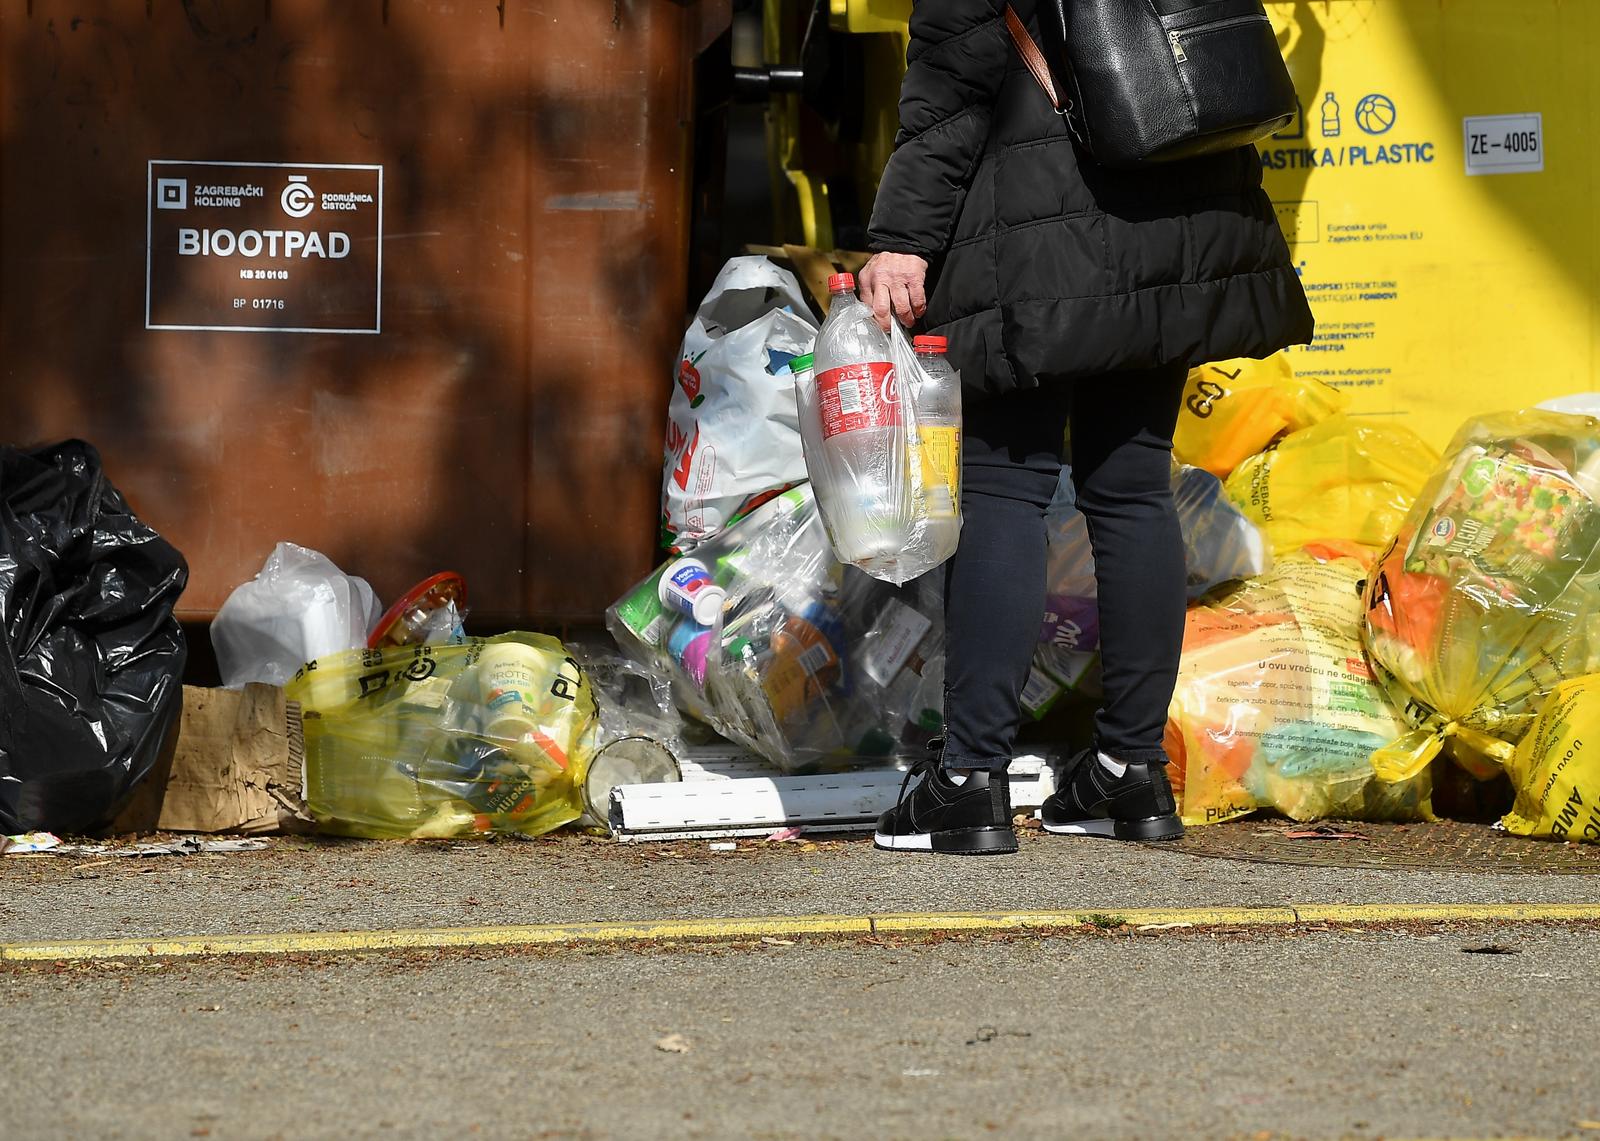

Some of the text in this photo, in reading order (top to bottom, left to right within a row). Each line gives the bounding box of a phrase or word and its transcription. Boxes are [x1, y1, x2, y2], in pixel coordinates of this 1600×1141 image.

[1261, 147, 1335, 170] ASTIKA
[1350, 142, 1434, 166] PLASTIC
[195, 184, 263, 197] ZAGREBAČKI
[195, 197, 241, 207] HOLDING
[322, 192, 373, 203] PODRUŽNICA
[1410, 231, 1423, 239] EU
[178, 228, 351, 259] BIOOTPAD
[1304, 283, 1342, 291] UROPSKI
[233, 299, 285, 309] BP 01716
[1313, 332, 1375, 340] NKURENTNOST
[1258, 661, 1265, 669] U
[1268, 662, 1287, 671] ovu
[1289, 663, 1324, 675] vrećicu
[1327, 669, 1338, 678] ne
[1274, 715, 1291, 724] boce
[1573, 739, 1583, 751] U
[1557, 750, 1573, 772] ovu
[1539, 773, 1558, 808] vrećic
[1551, 785, 1584, 842] AMB
